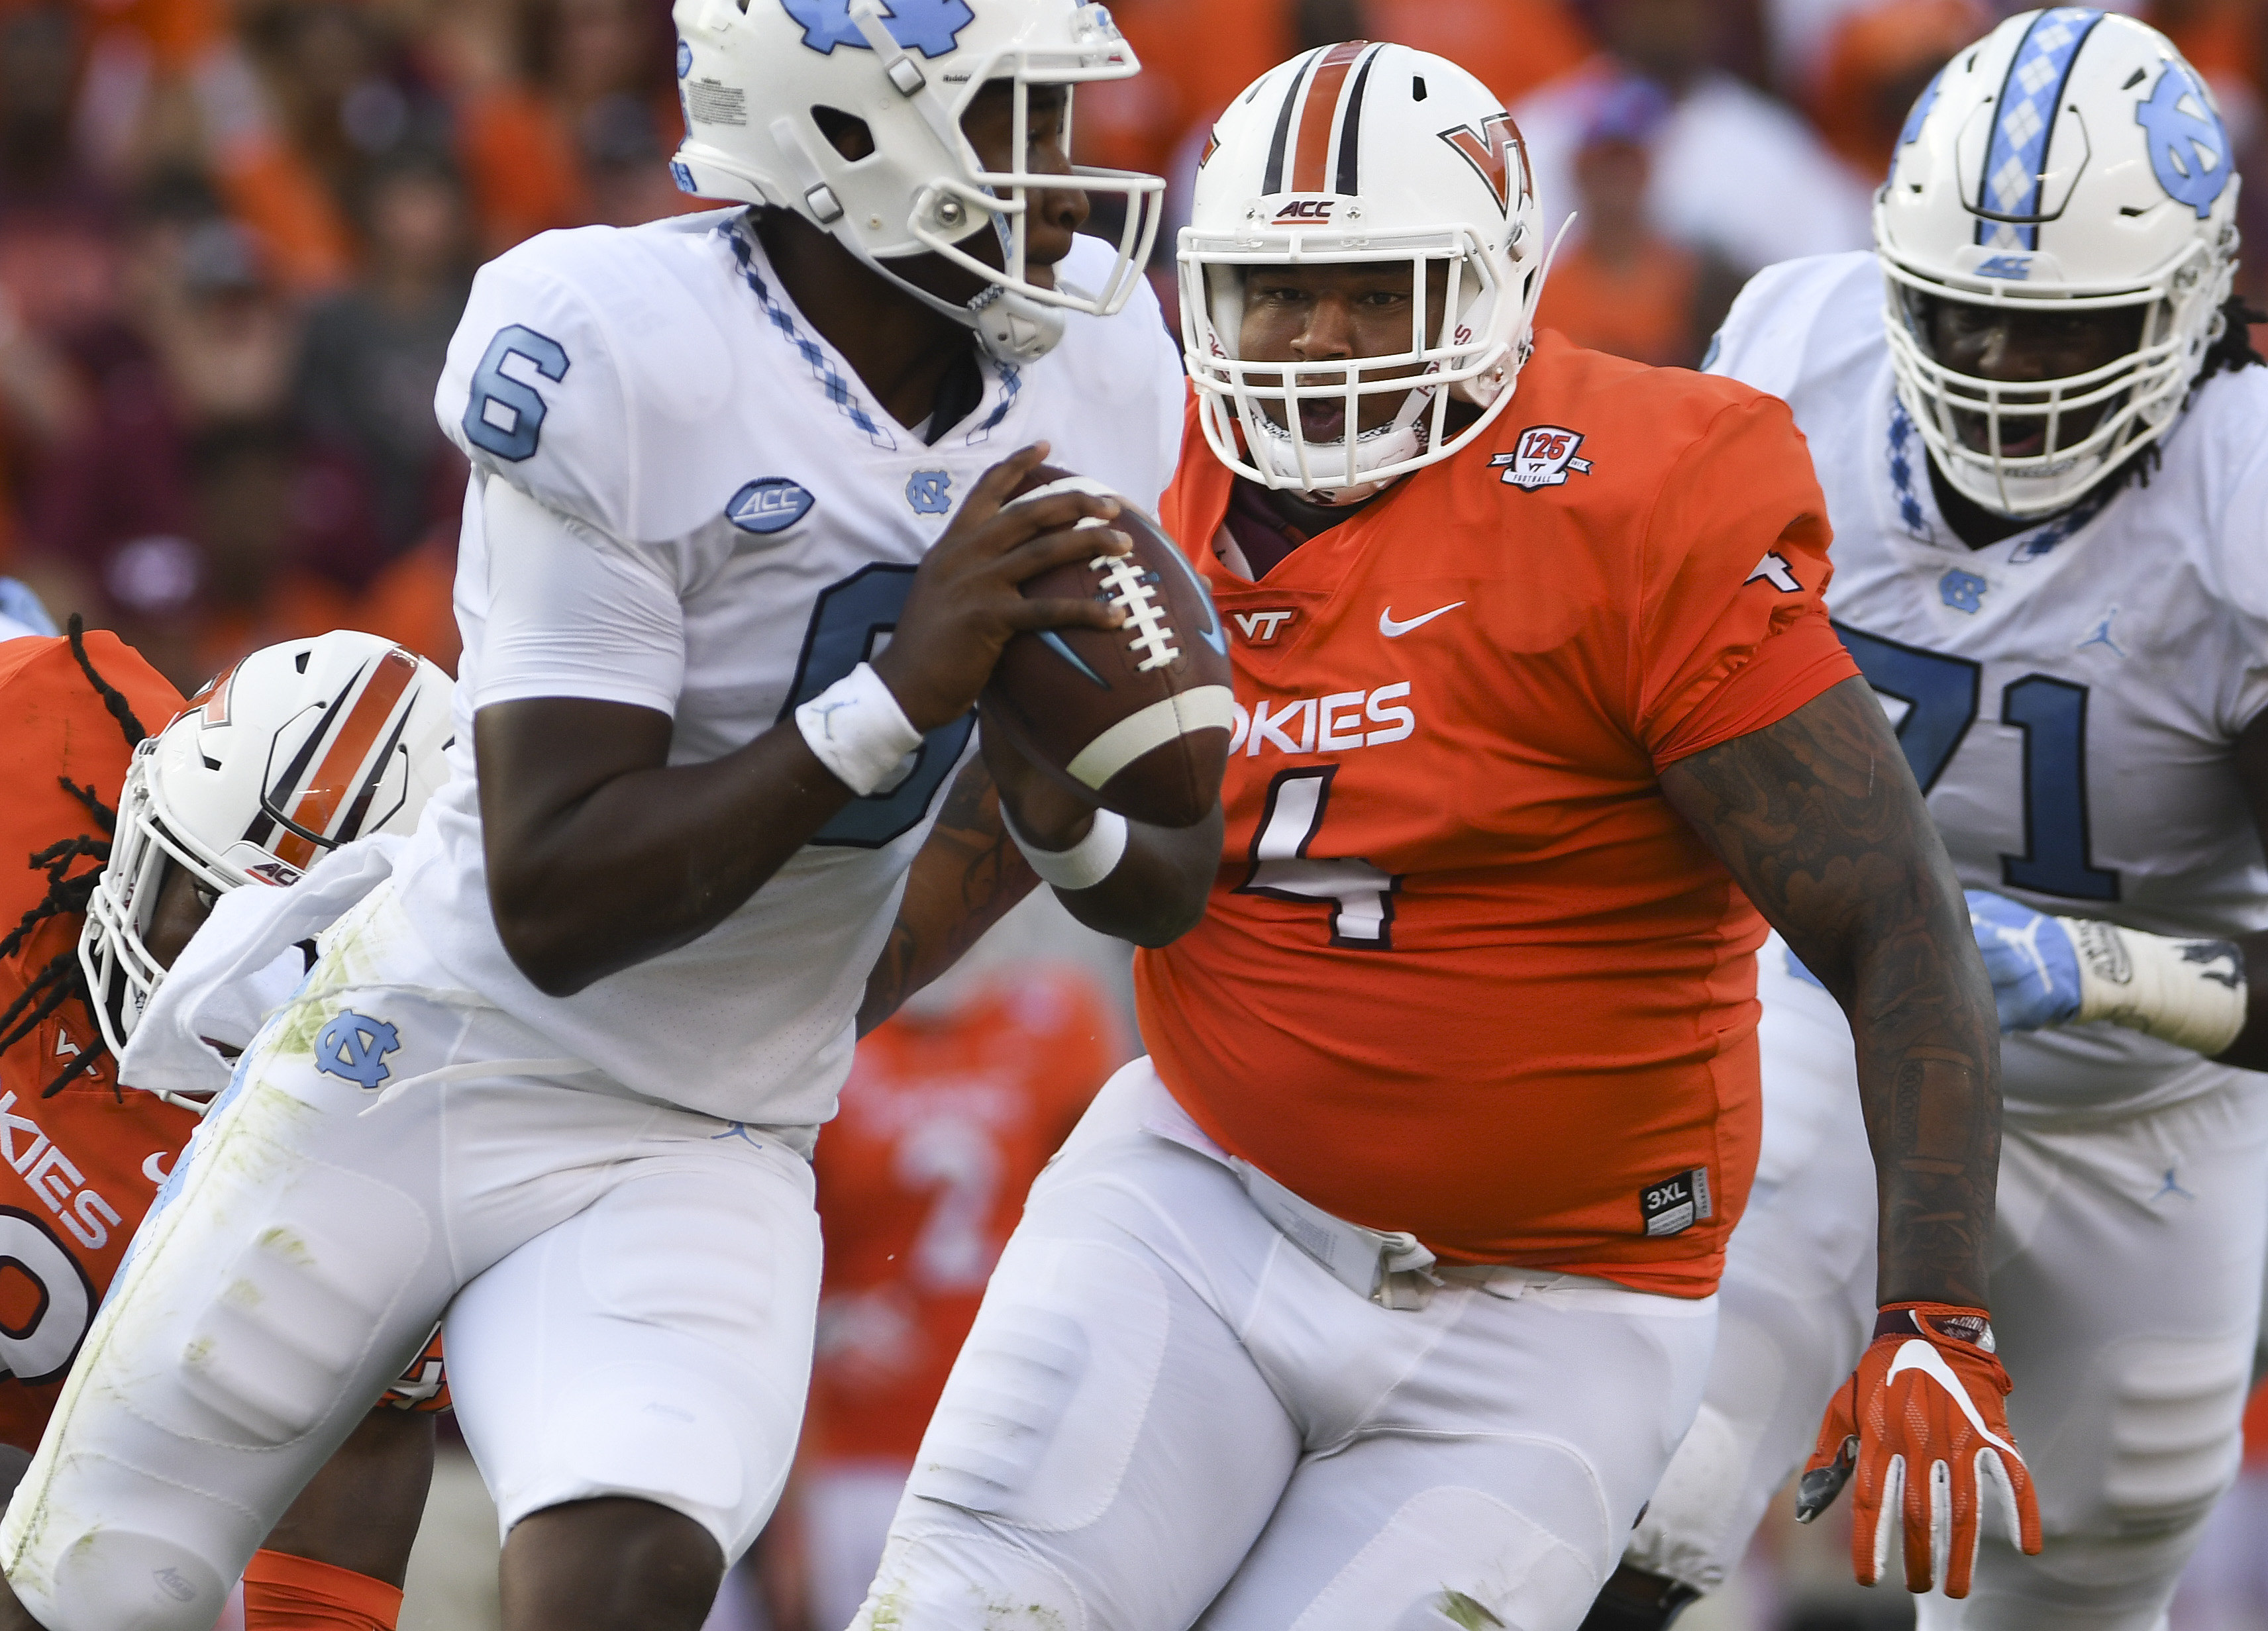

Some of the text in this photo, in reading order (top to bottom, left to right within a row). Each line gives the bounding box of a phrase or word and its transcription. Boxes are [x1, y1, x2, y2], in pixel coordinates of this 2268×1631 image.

[1276, 201, 1335, 218] ACC
[461, 322, 570, 462] 6
[1522, 432, 1571, 460] 125
[1513, 473, 1552, 483] FOOTBALL
[1528, 462, 1547, 473] VT
[737, 486, 801, 516] ACC
[1233, 611, 1292, 640] VT
[1831, 620, 2120, 902] 71
[1229, 764, 1409, 950] 4
[1647, 1182, 1687, 1209] 3XL
